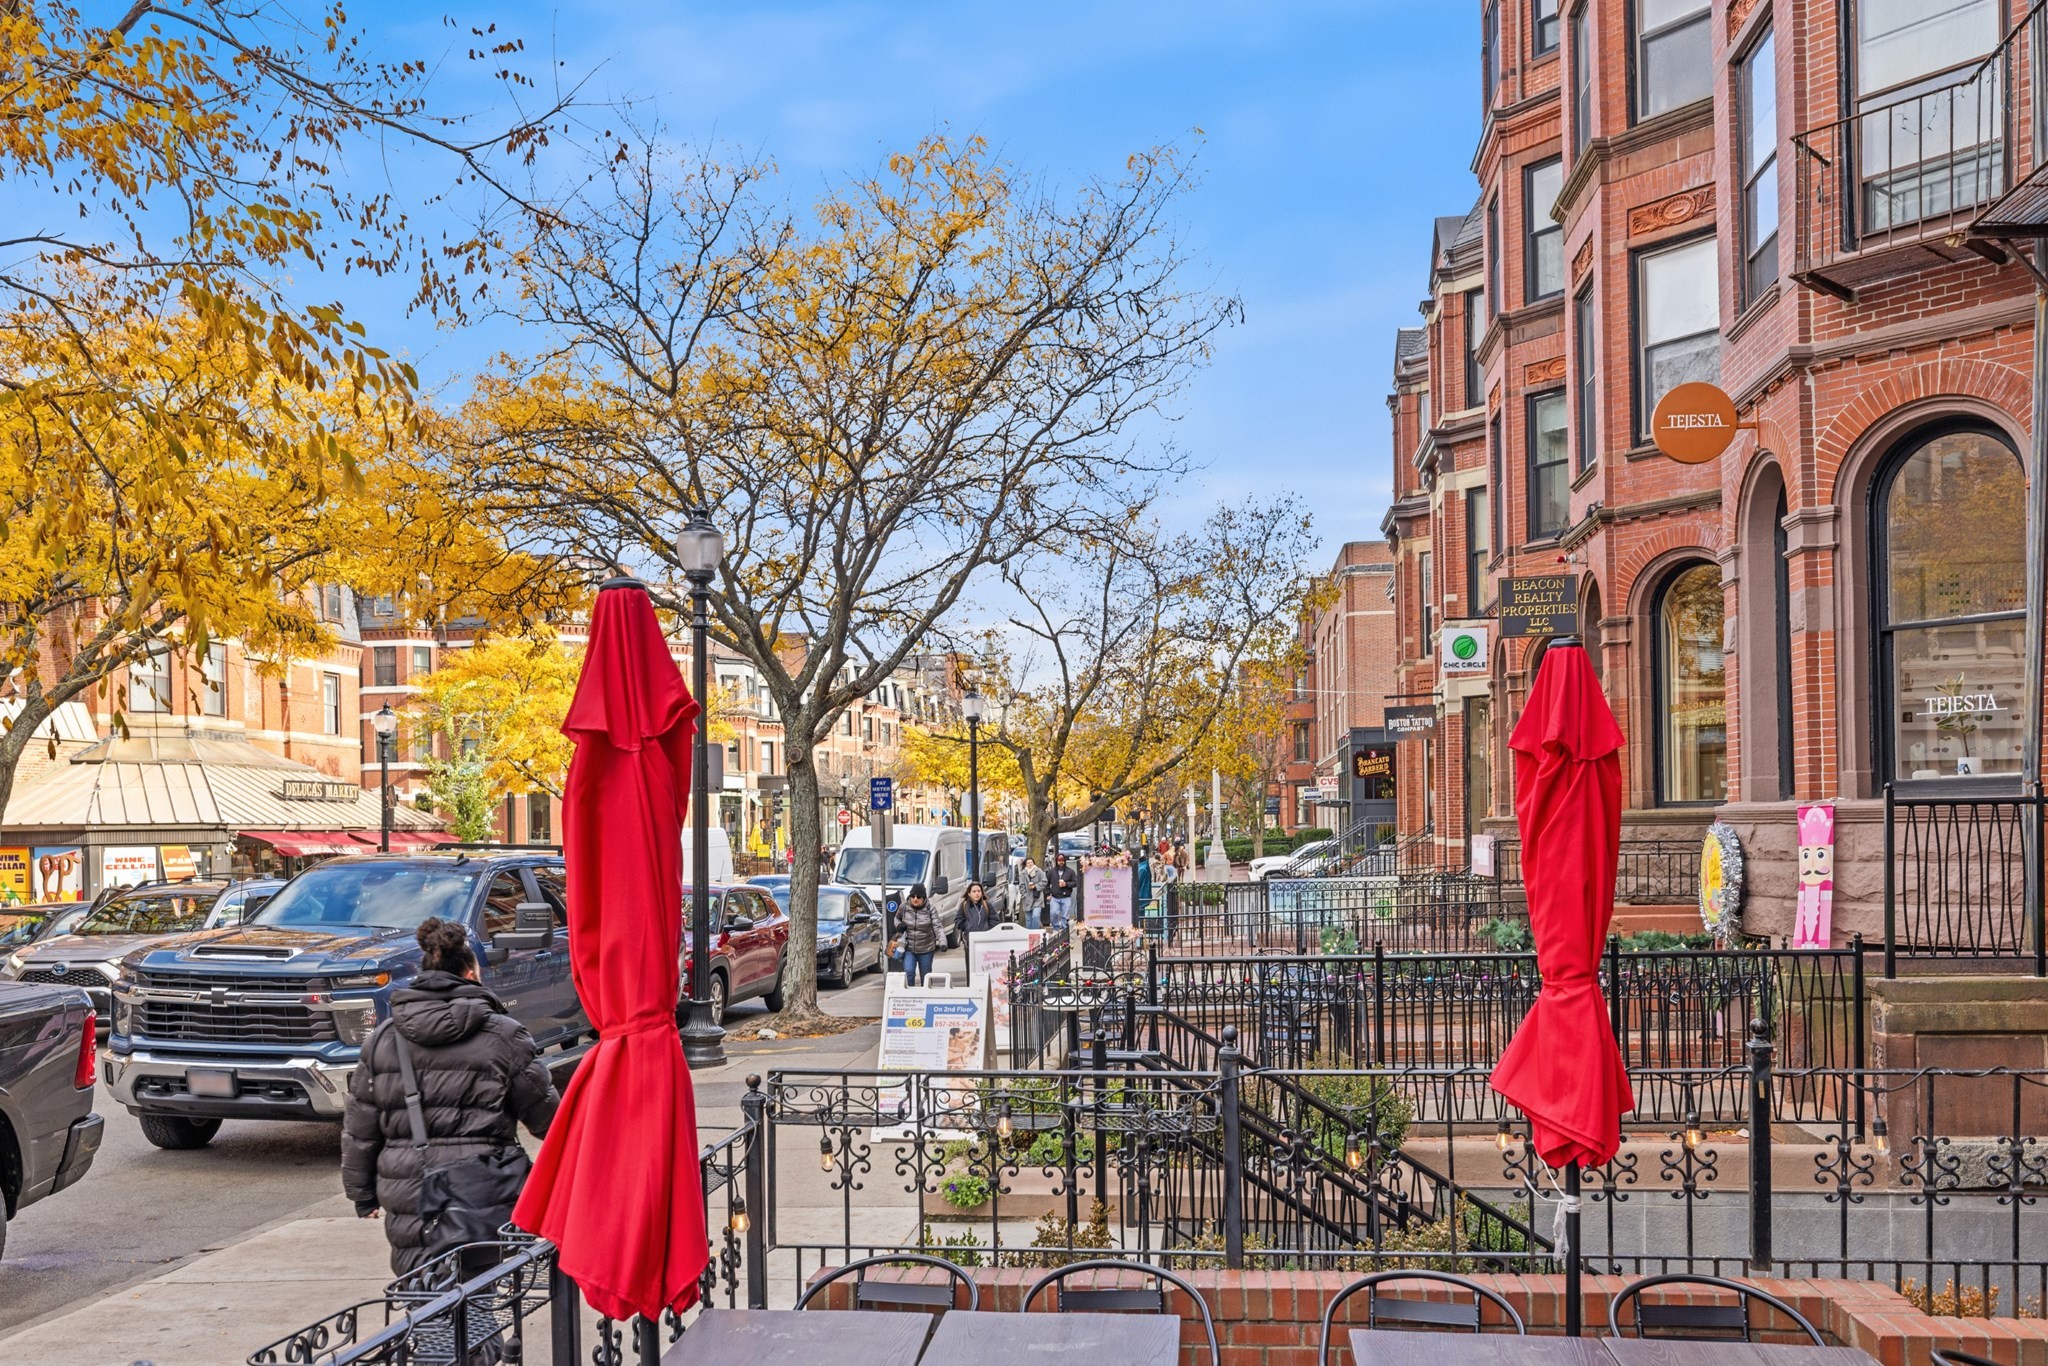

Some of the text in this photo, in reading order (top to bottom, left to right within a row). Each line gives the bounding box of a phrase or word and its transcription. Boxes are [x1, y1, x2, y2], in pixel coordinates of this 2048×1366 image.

[1667, 413, 1723, 431] TEJESTA
[1512, 578, 1565, 591] BEACON
[1514, 591, 1564, 604] REALTY
[1502, 603, 1577, 617] PROPERTIES
[1529, 617, 1550, 626] LLC
[1924, 693, 1999, 718] TEJESTA
[1388, 717, 1433, 730] BOSTON TATTOO
[1320, 777, 1338, 786] CVS
[325, 783, 359, 799] MARKET
